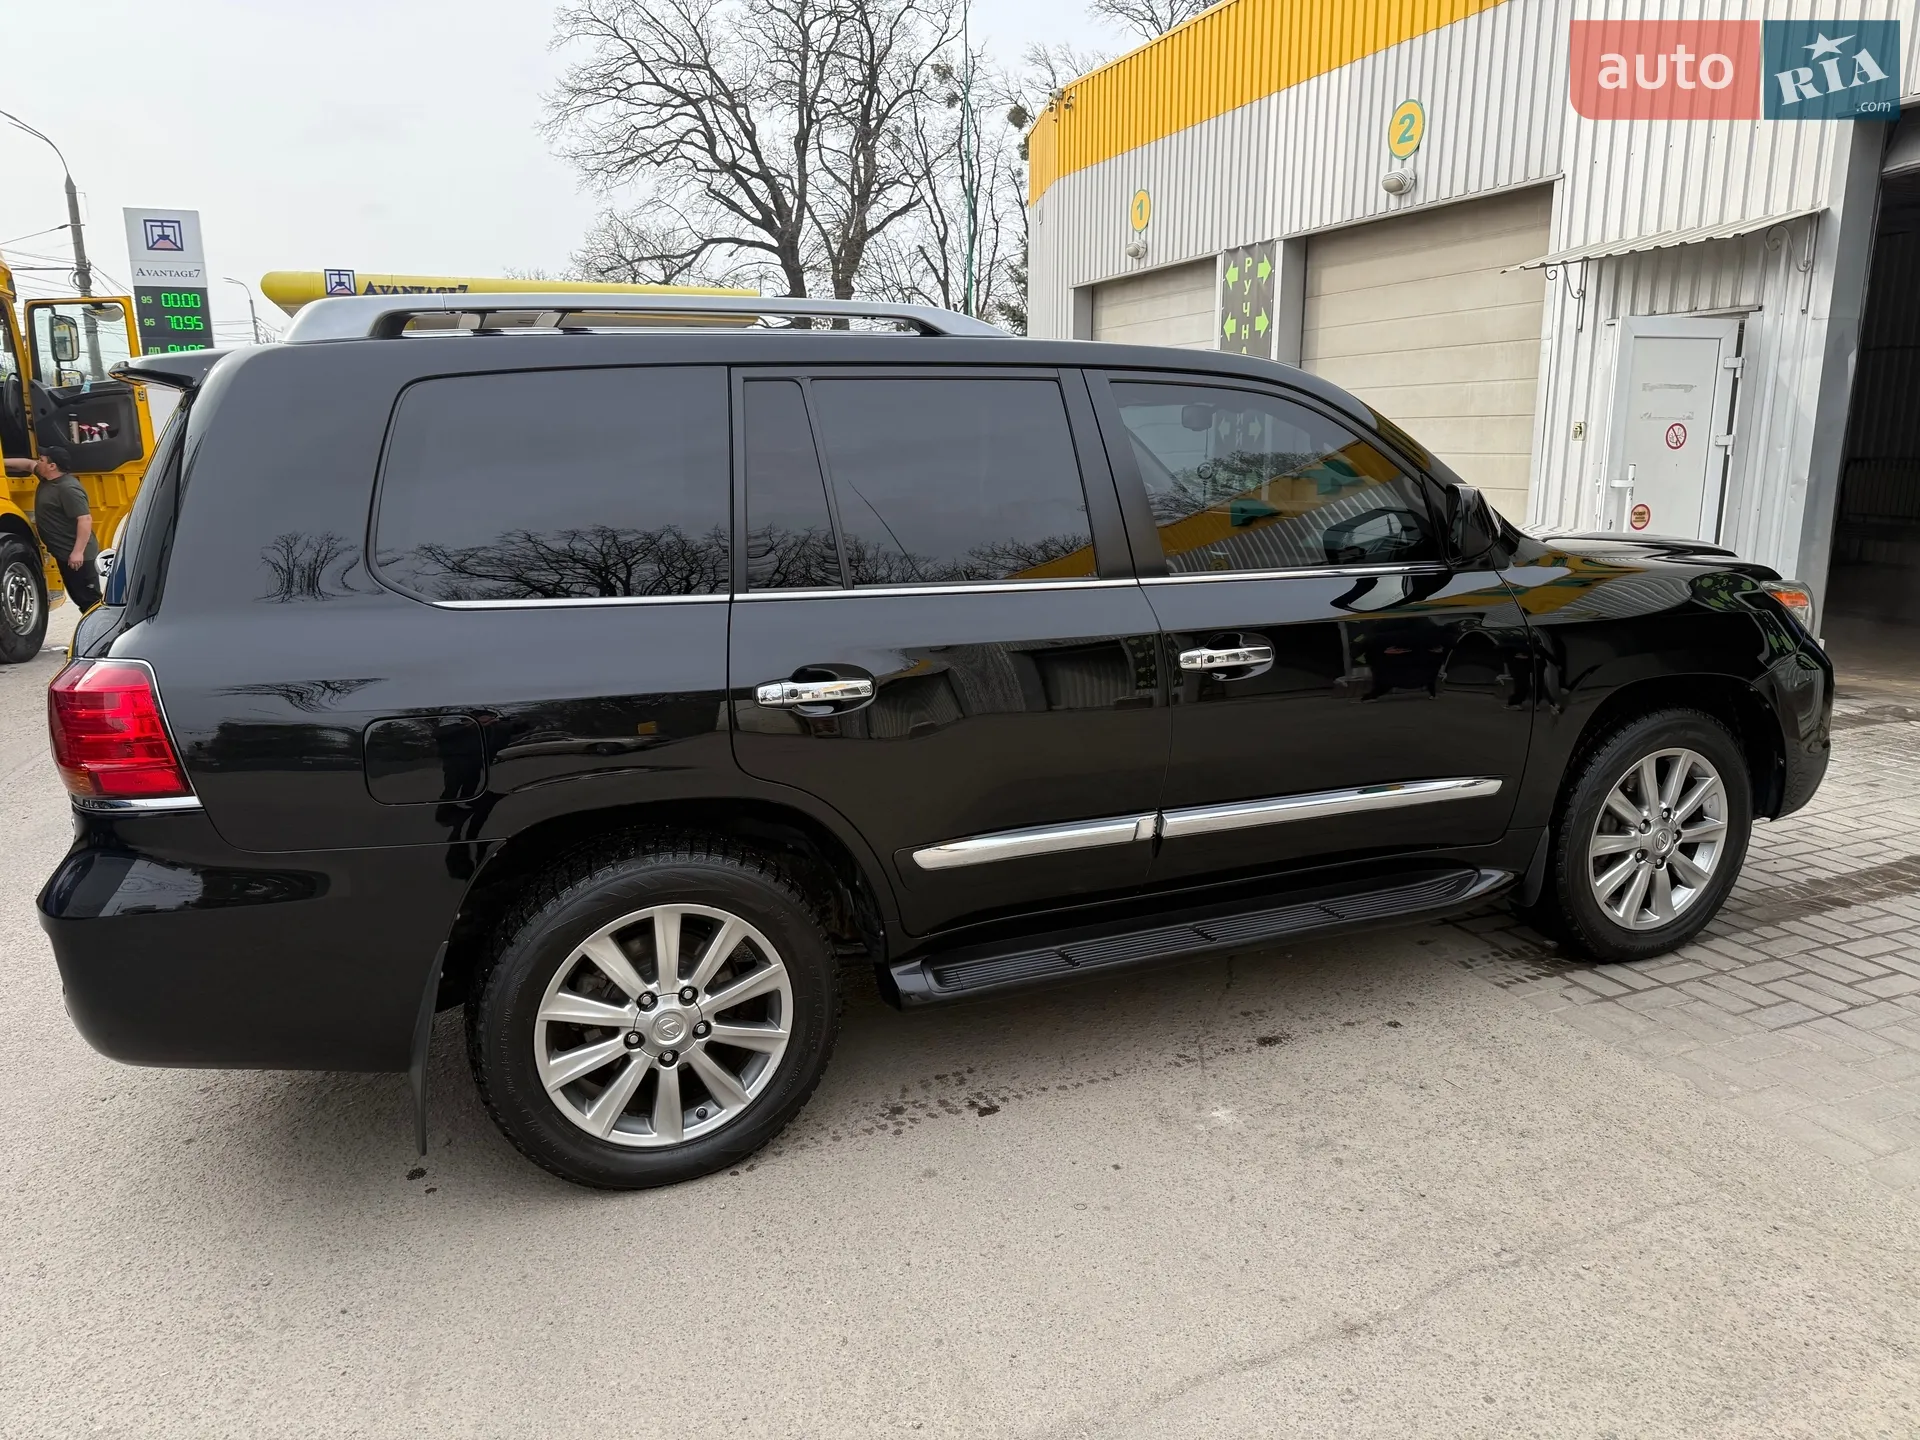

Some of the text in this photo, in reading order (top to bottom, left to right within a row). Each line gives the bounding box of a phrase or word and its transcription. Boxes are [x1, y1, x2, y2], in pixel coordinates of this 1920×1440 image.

[1396, 113, 1415, 145] 2
[1136, 198, 1144, 221] 1
[136, 267, 201, 278] AVANTAGE7
[140, 292, 201, 308] 95 00.00
[143, 315, 204, 330] 95 70.95
